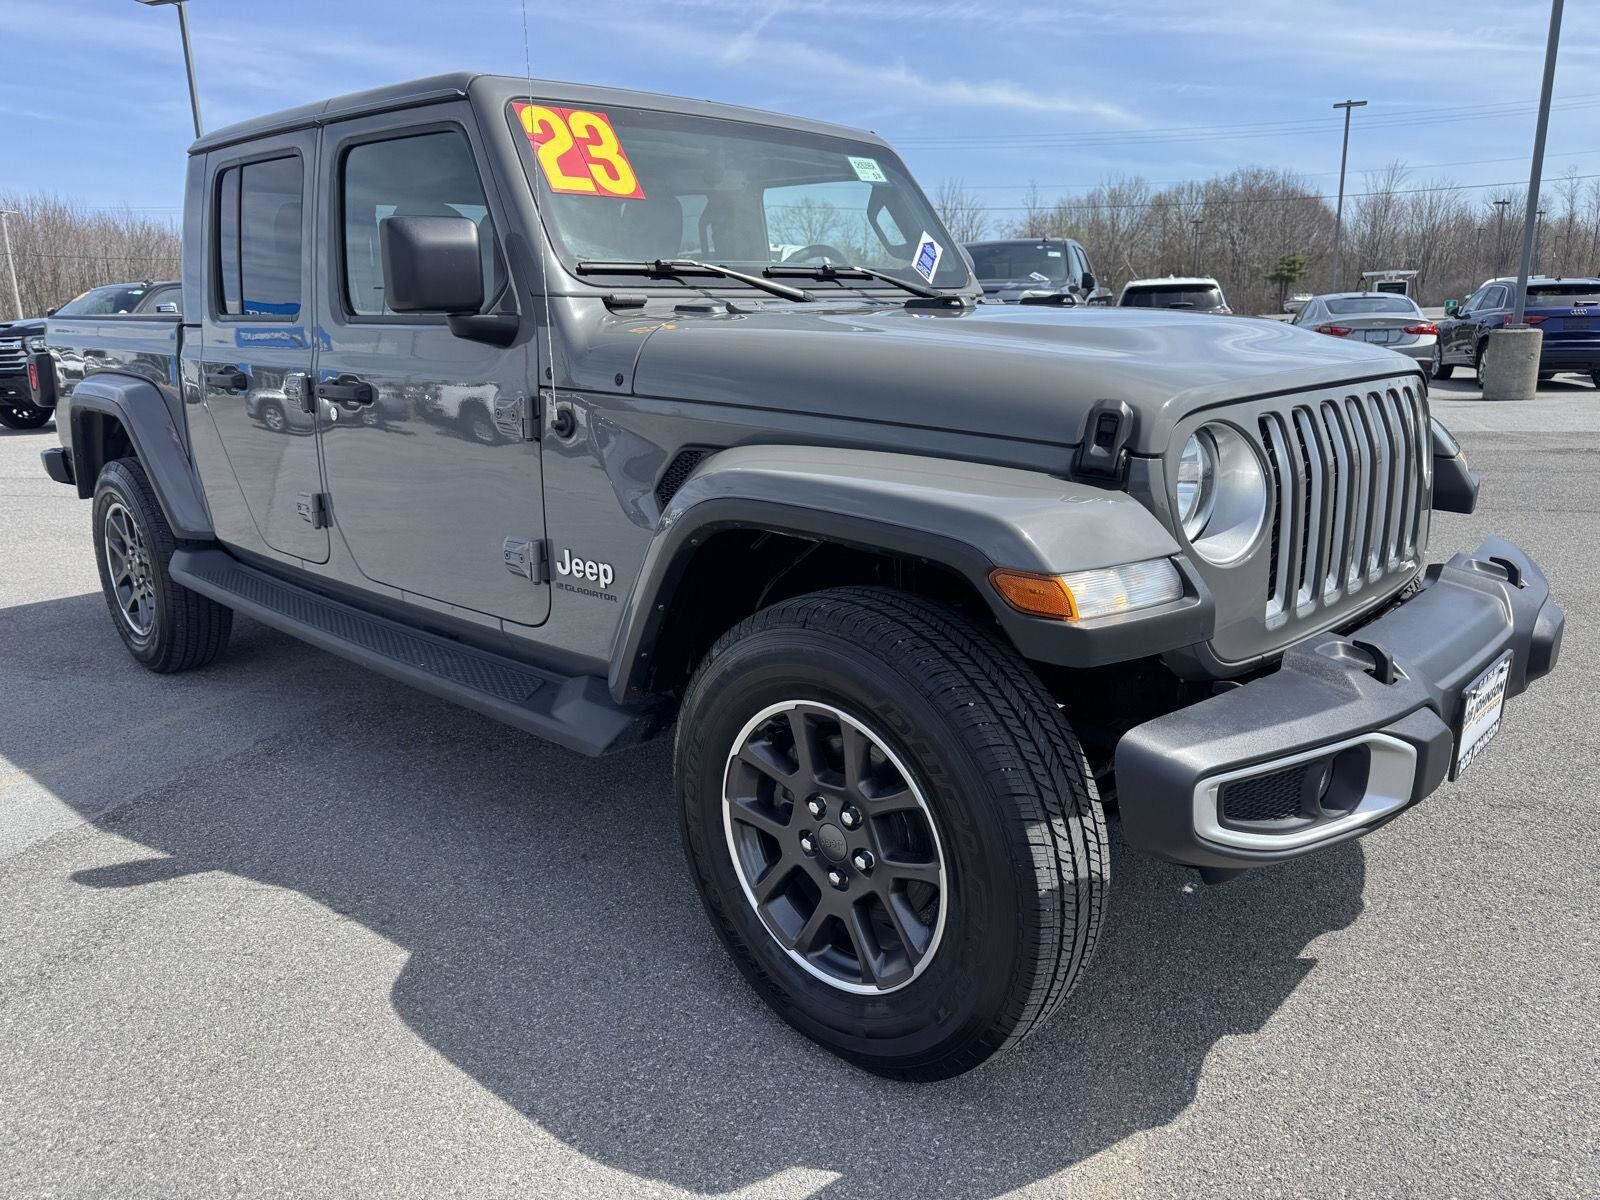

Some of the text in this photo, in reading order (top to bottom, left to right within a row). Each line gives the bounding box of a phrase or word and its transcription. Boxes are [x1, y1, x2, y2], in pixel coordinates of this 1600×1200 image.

[520, 105, 637, 195] 23
[556, 549, 614, 588] Jeep
[564, 584, 618, 602] GLADIATOR
